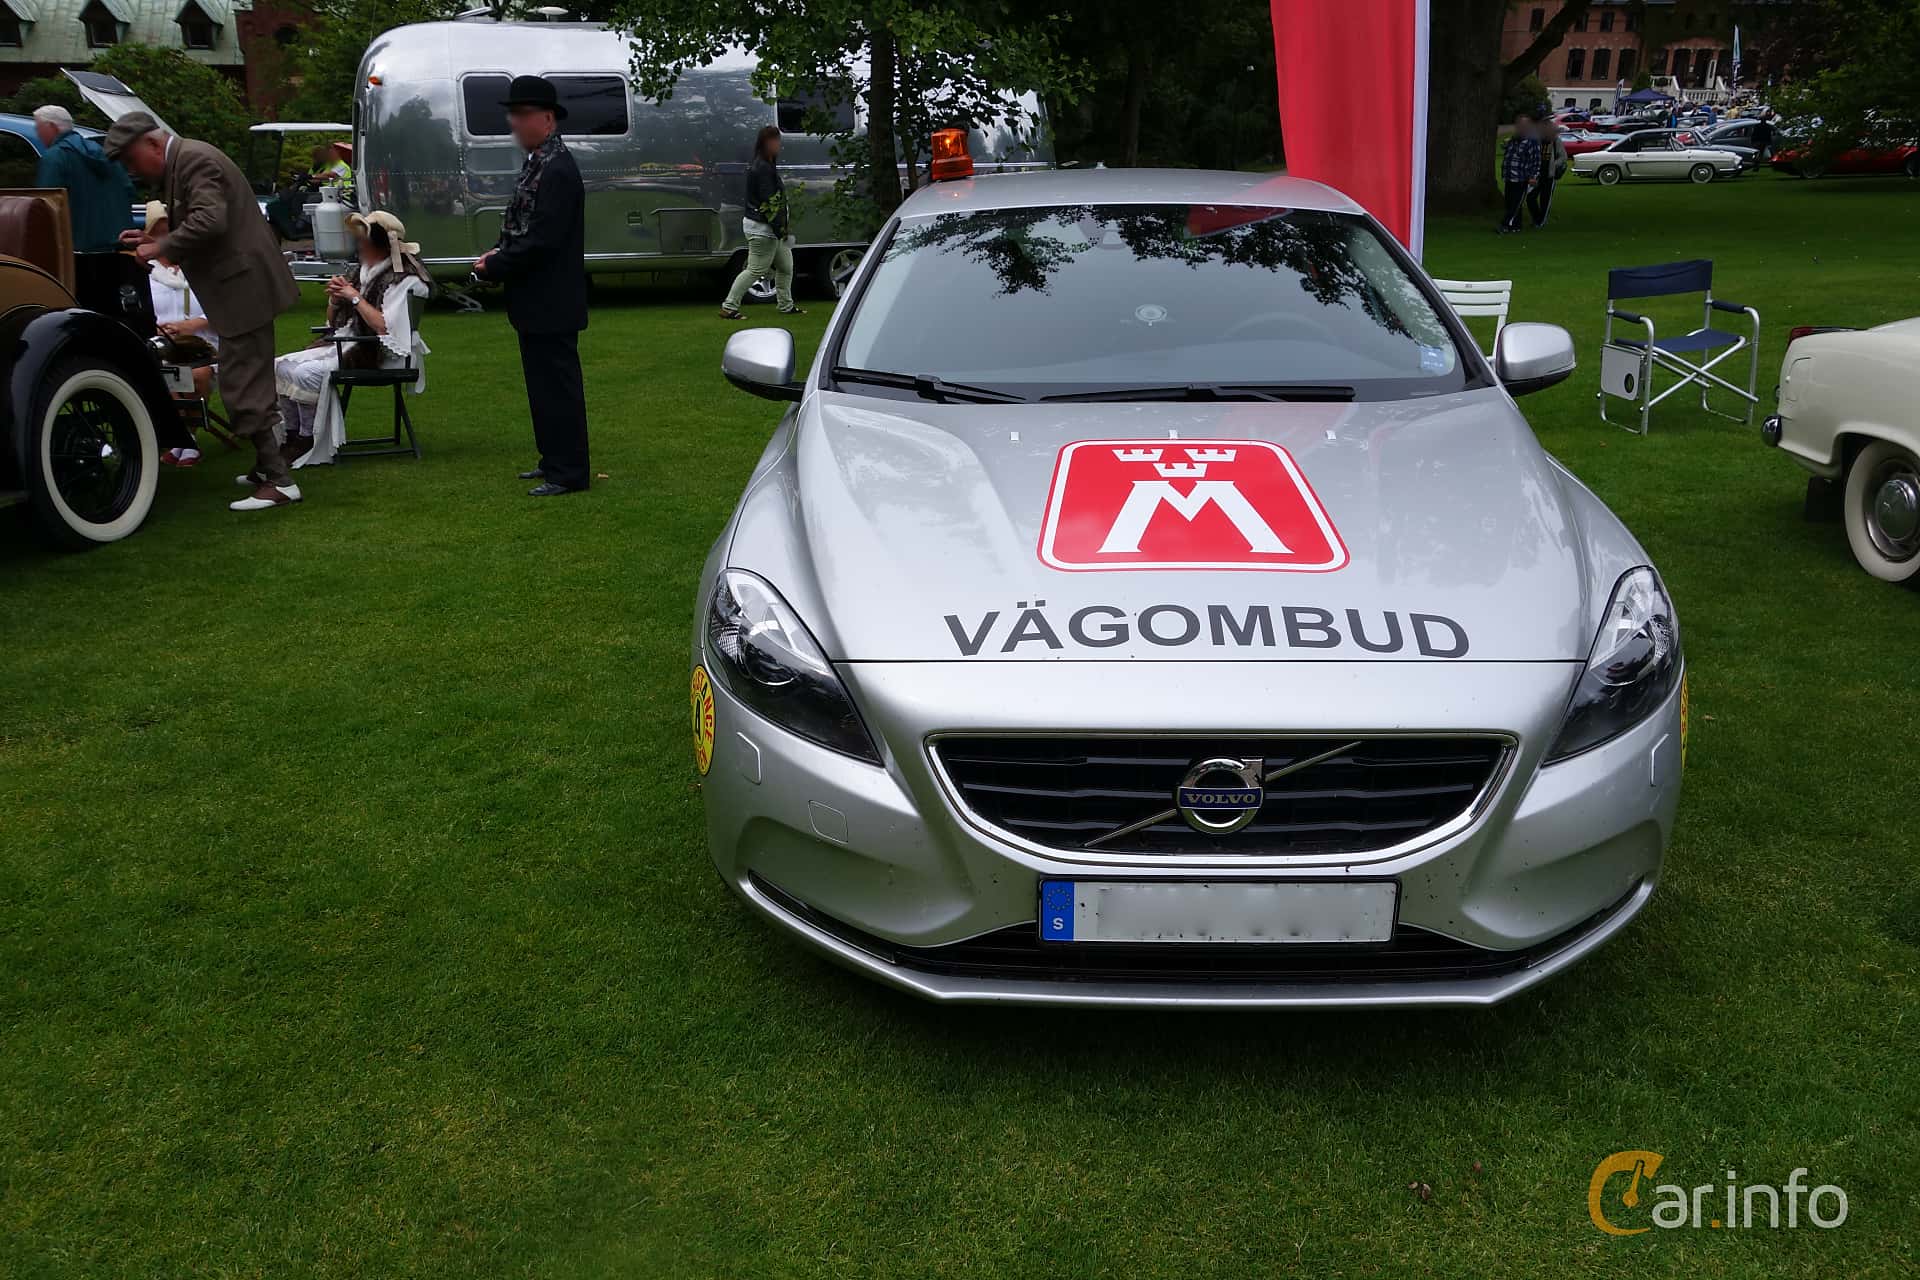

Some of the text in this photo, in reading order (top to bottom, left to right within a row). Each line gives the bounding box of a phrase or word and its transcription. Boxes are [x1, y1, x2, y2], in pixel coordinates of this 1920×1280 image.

[1095, 480, 1295, 554] M
[943, 599, 1470, 659] VÄGOMBUD
[1184, 793, 1256, 804] VOLVO
[1052, 917, 1064, 930] S
